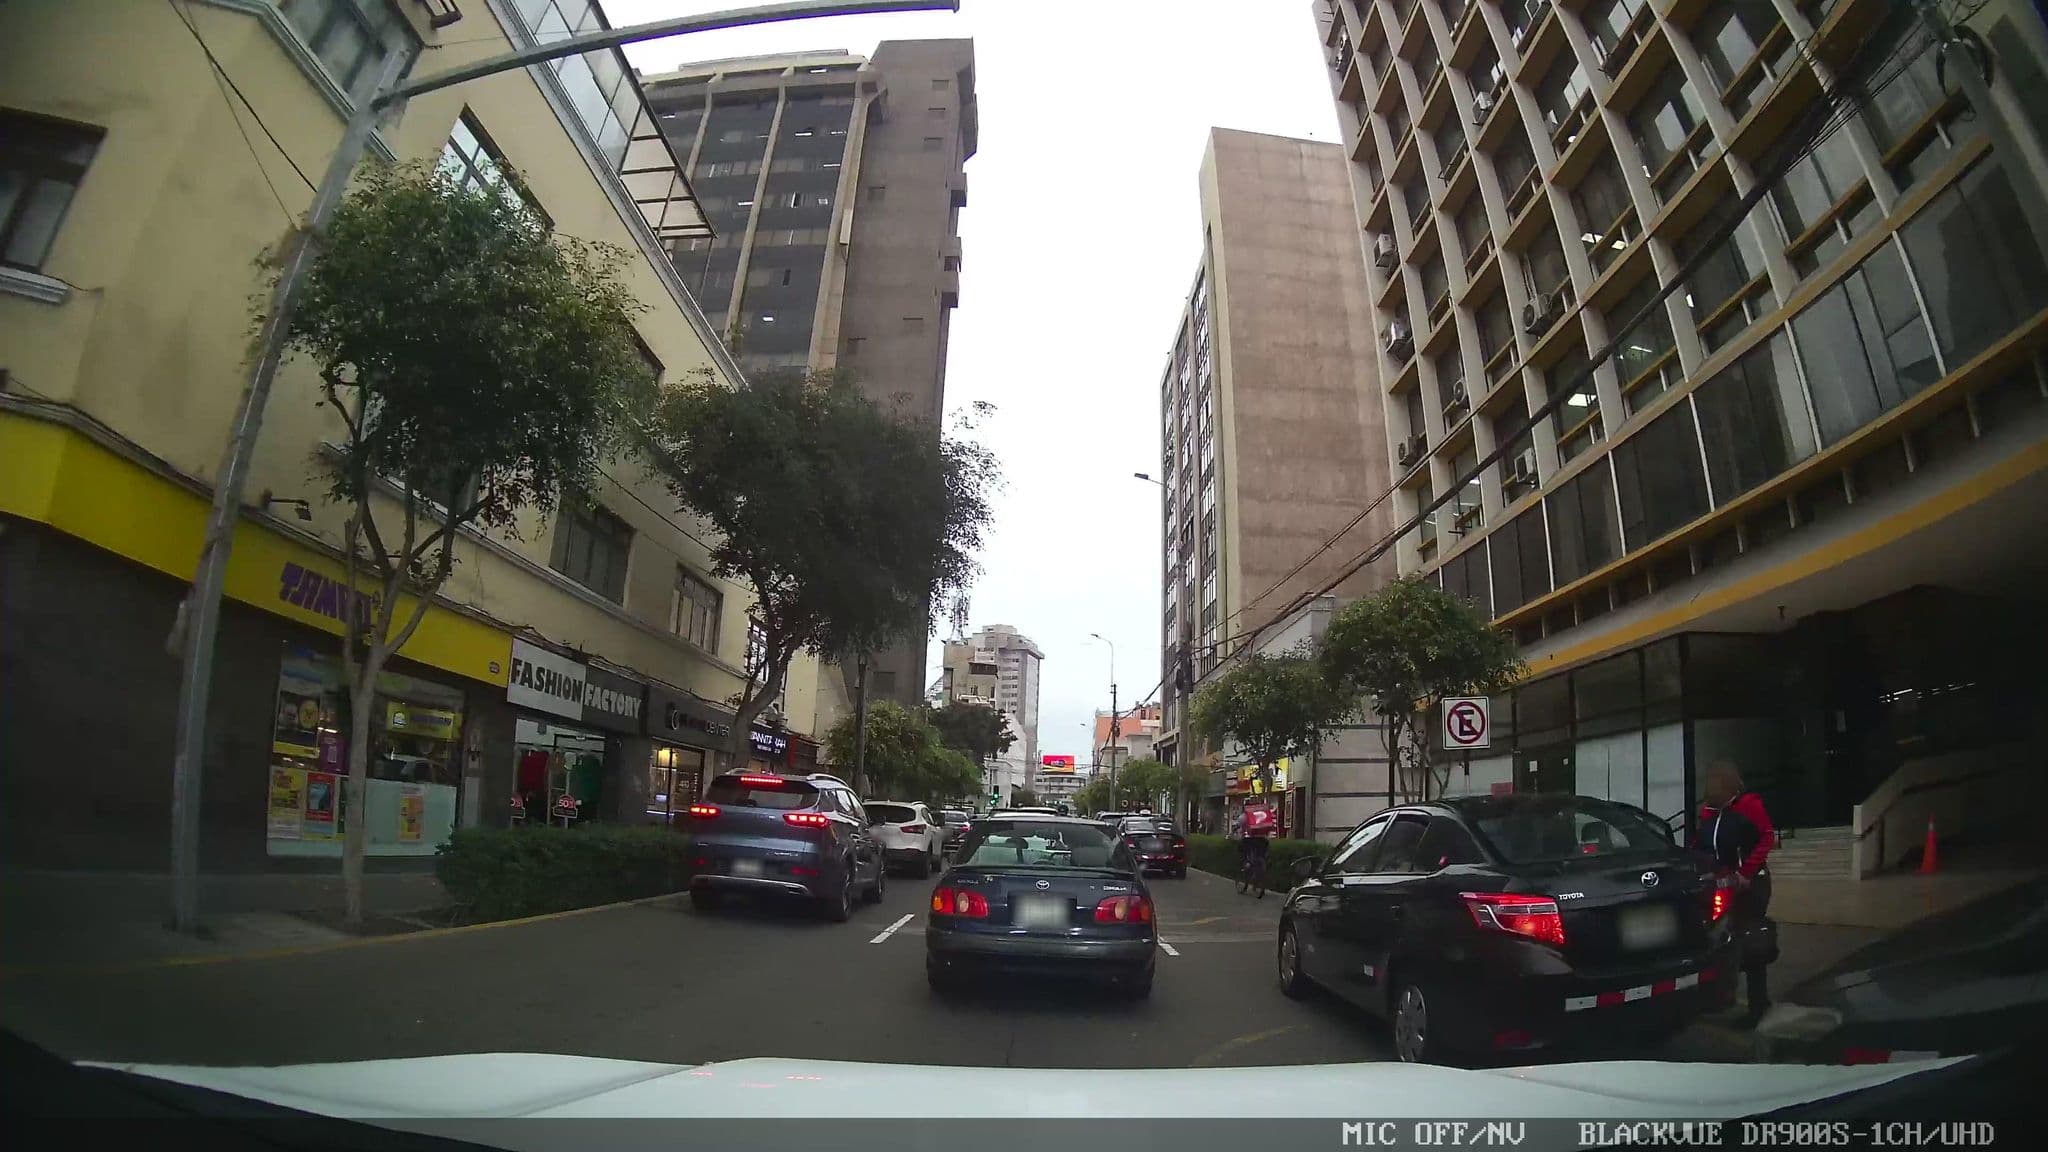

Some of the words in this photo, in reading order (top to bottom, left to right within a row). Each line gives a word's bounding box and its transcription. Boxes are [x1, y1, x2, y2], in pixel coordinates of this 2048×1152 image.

[511, 657, 583, 703] FASHION
[585, 683, 642, 719] FACTORY
[1559, 892, 1585, 900] TOYOTA
